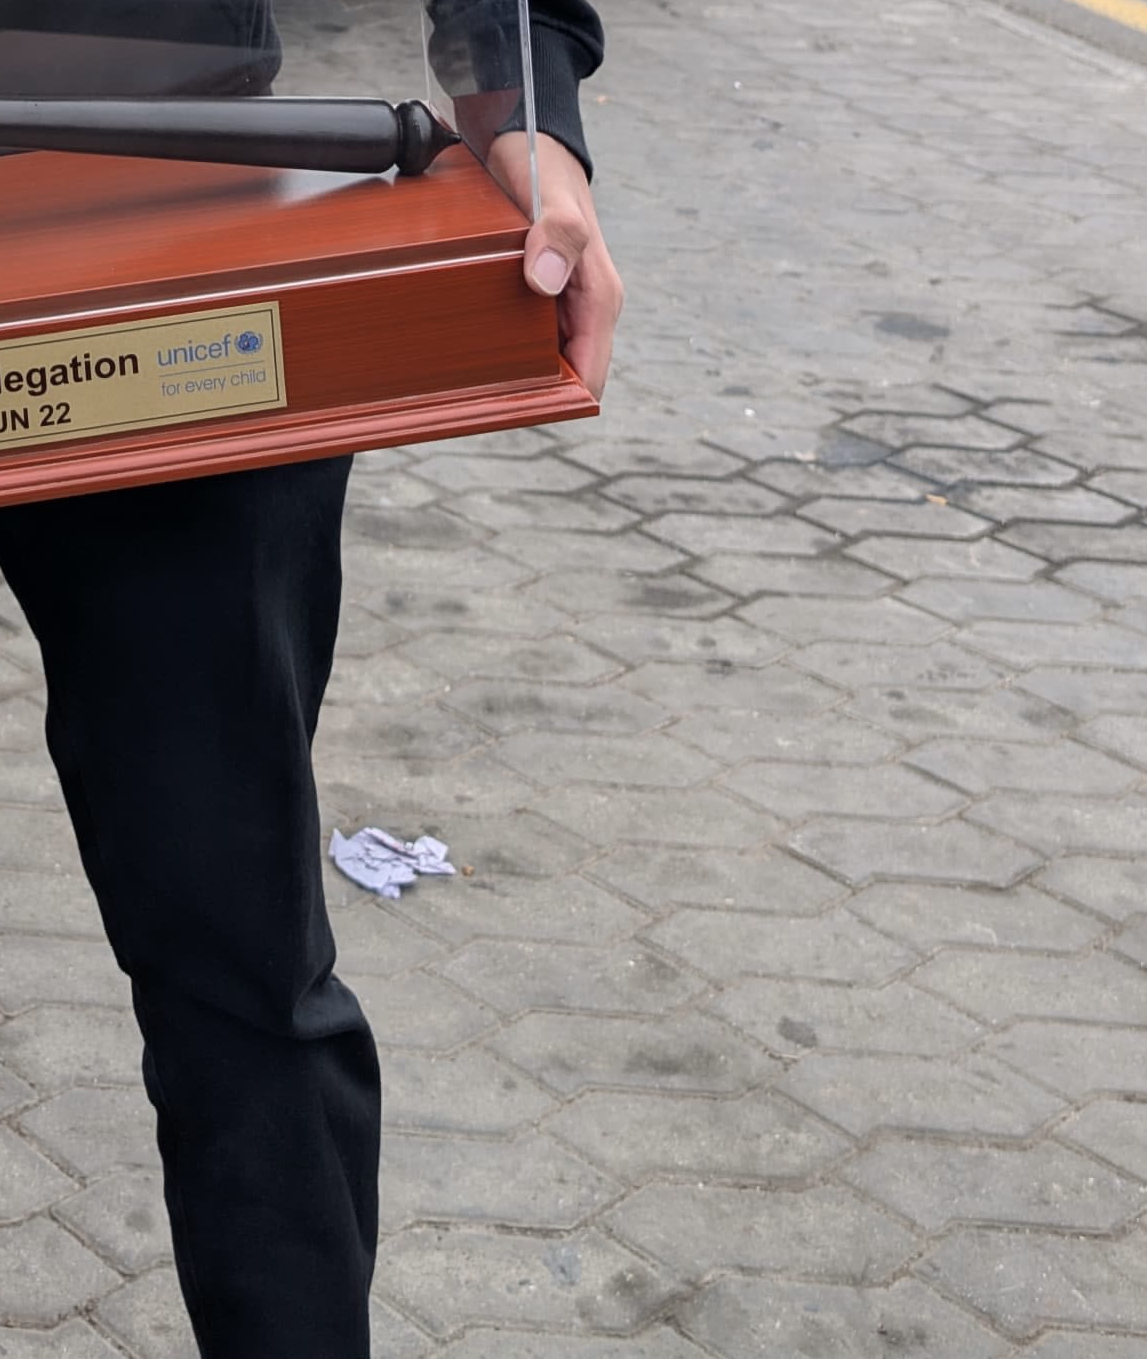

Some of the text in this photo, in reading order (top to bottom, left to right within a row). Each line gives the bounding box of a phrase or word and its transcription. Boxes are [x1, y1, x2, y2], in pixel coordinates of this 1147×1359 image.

[156, 333, 232, 367] unicef
[161, 368, 267, 397] for every child
[39, 401, 72, 427] 22
